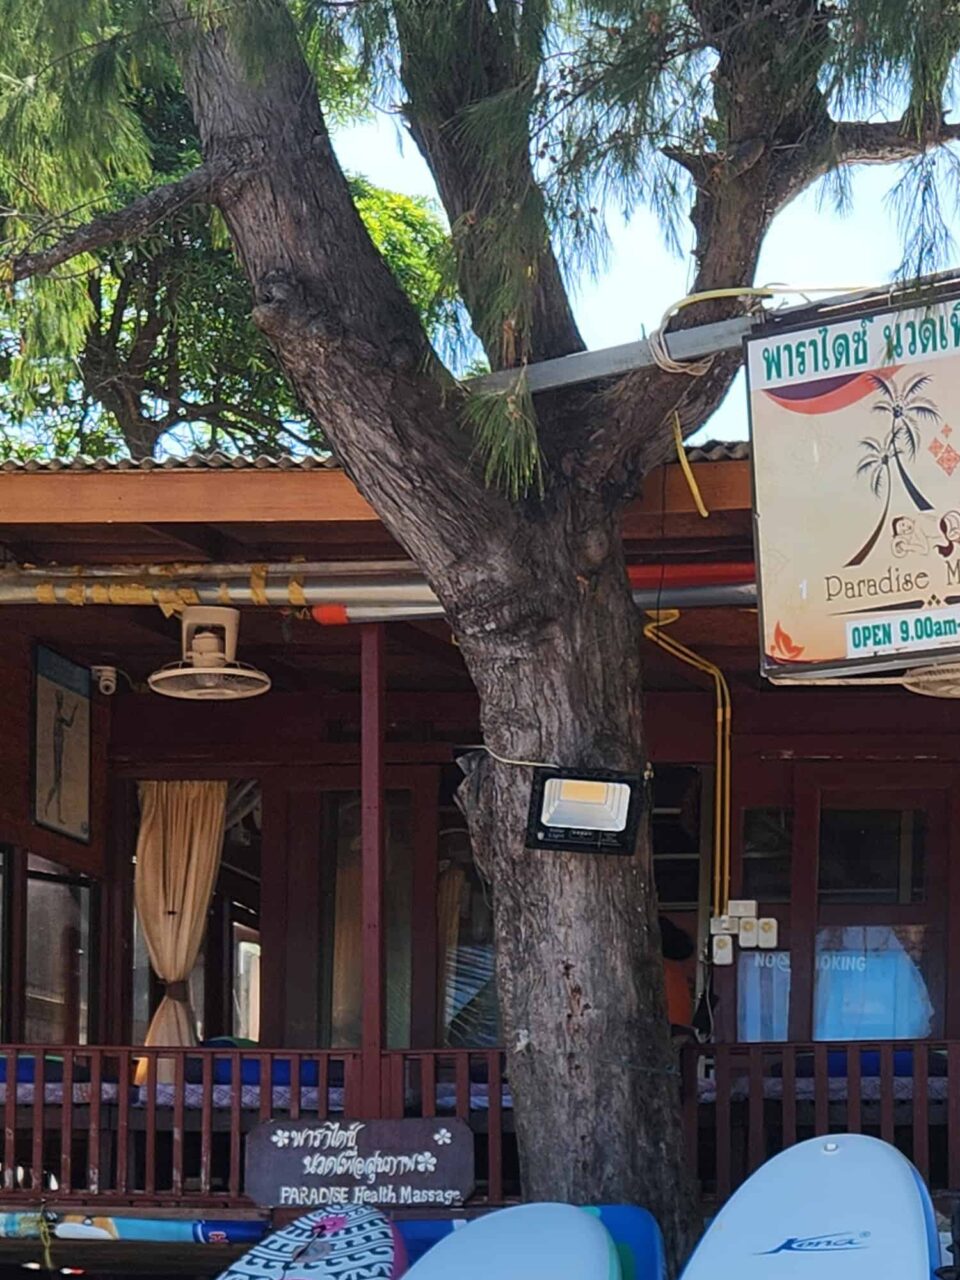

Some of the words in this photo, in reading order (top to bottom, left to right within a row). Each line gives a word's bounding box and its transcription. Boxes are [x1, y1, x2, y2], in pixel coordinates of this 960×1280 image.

[825, 566, 930, 602] Paradise
[852, 623, 892, 648] OPEN
[754, 953, 773, 968] NO
[279, 1186, 350, 1206] PARADISE
[353, 1184, 397, 1204] Health
